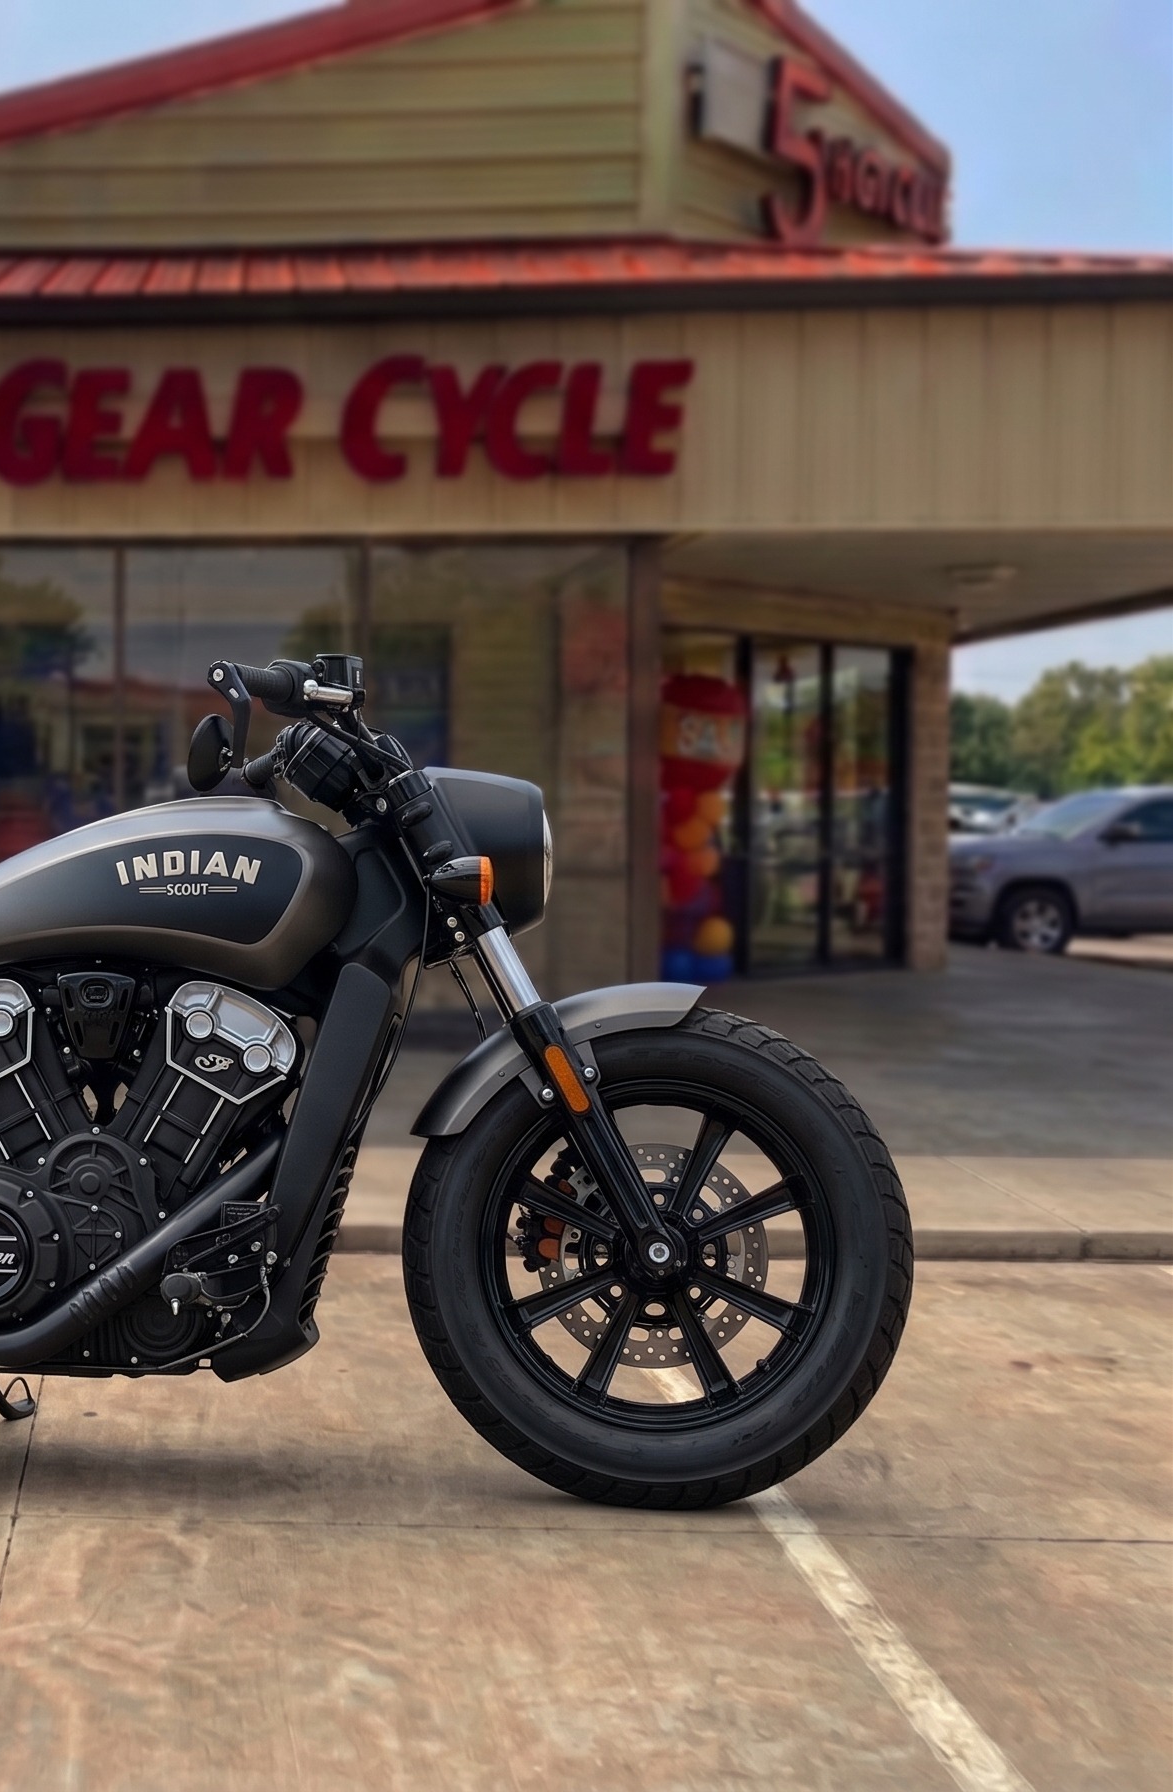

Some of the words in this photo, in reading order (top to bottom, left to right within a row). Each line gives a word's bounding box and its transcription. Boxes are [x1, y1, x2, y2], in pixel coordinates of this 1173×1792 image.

[340, 353, 696, 484] CYCLE
[116, 850, 262, 886] INDIAN
[166, 883, 209, 896] SCOUT
